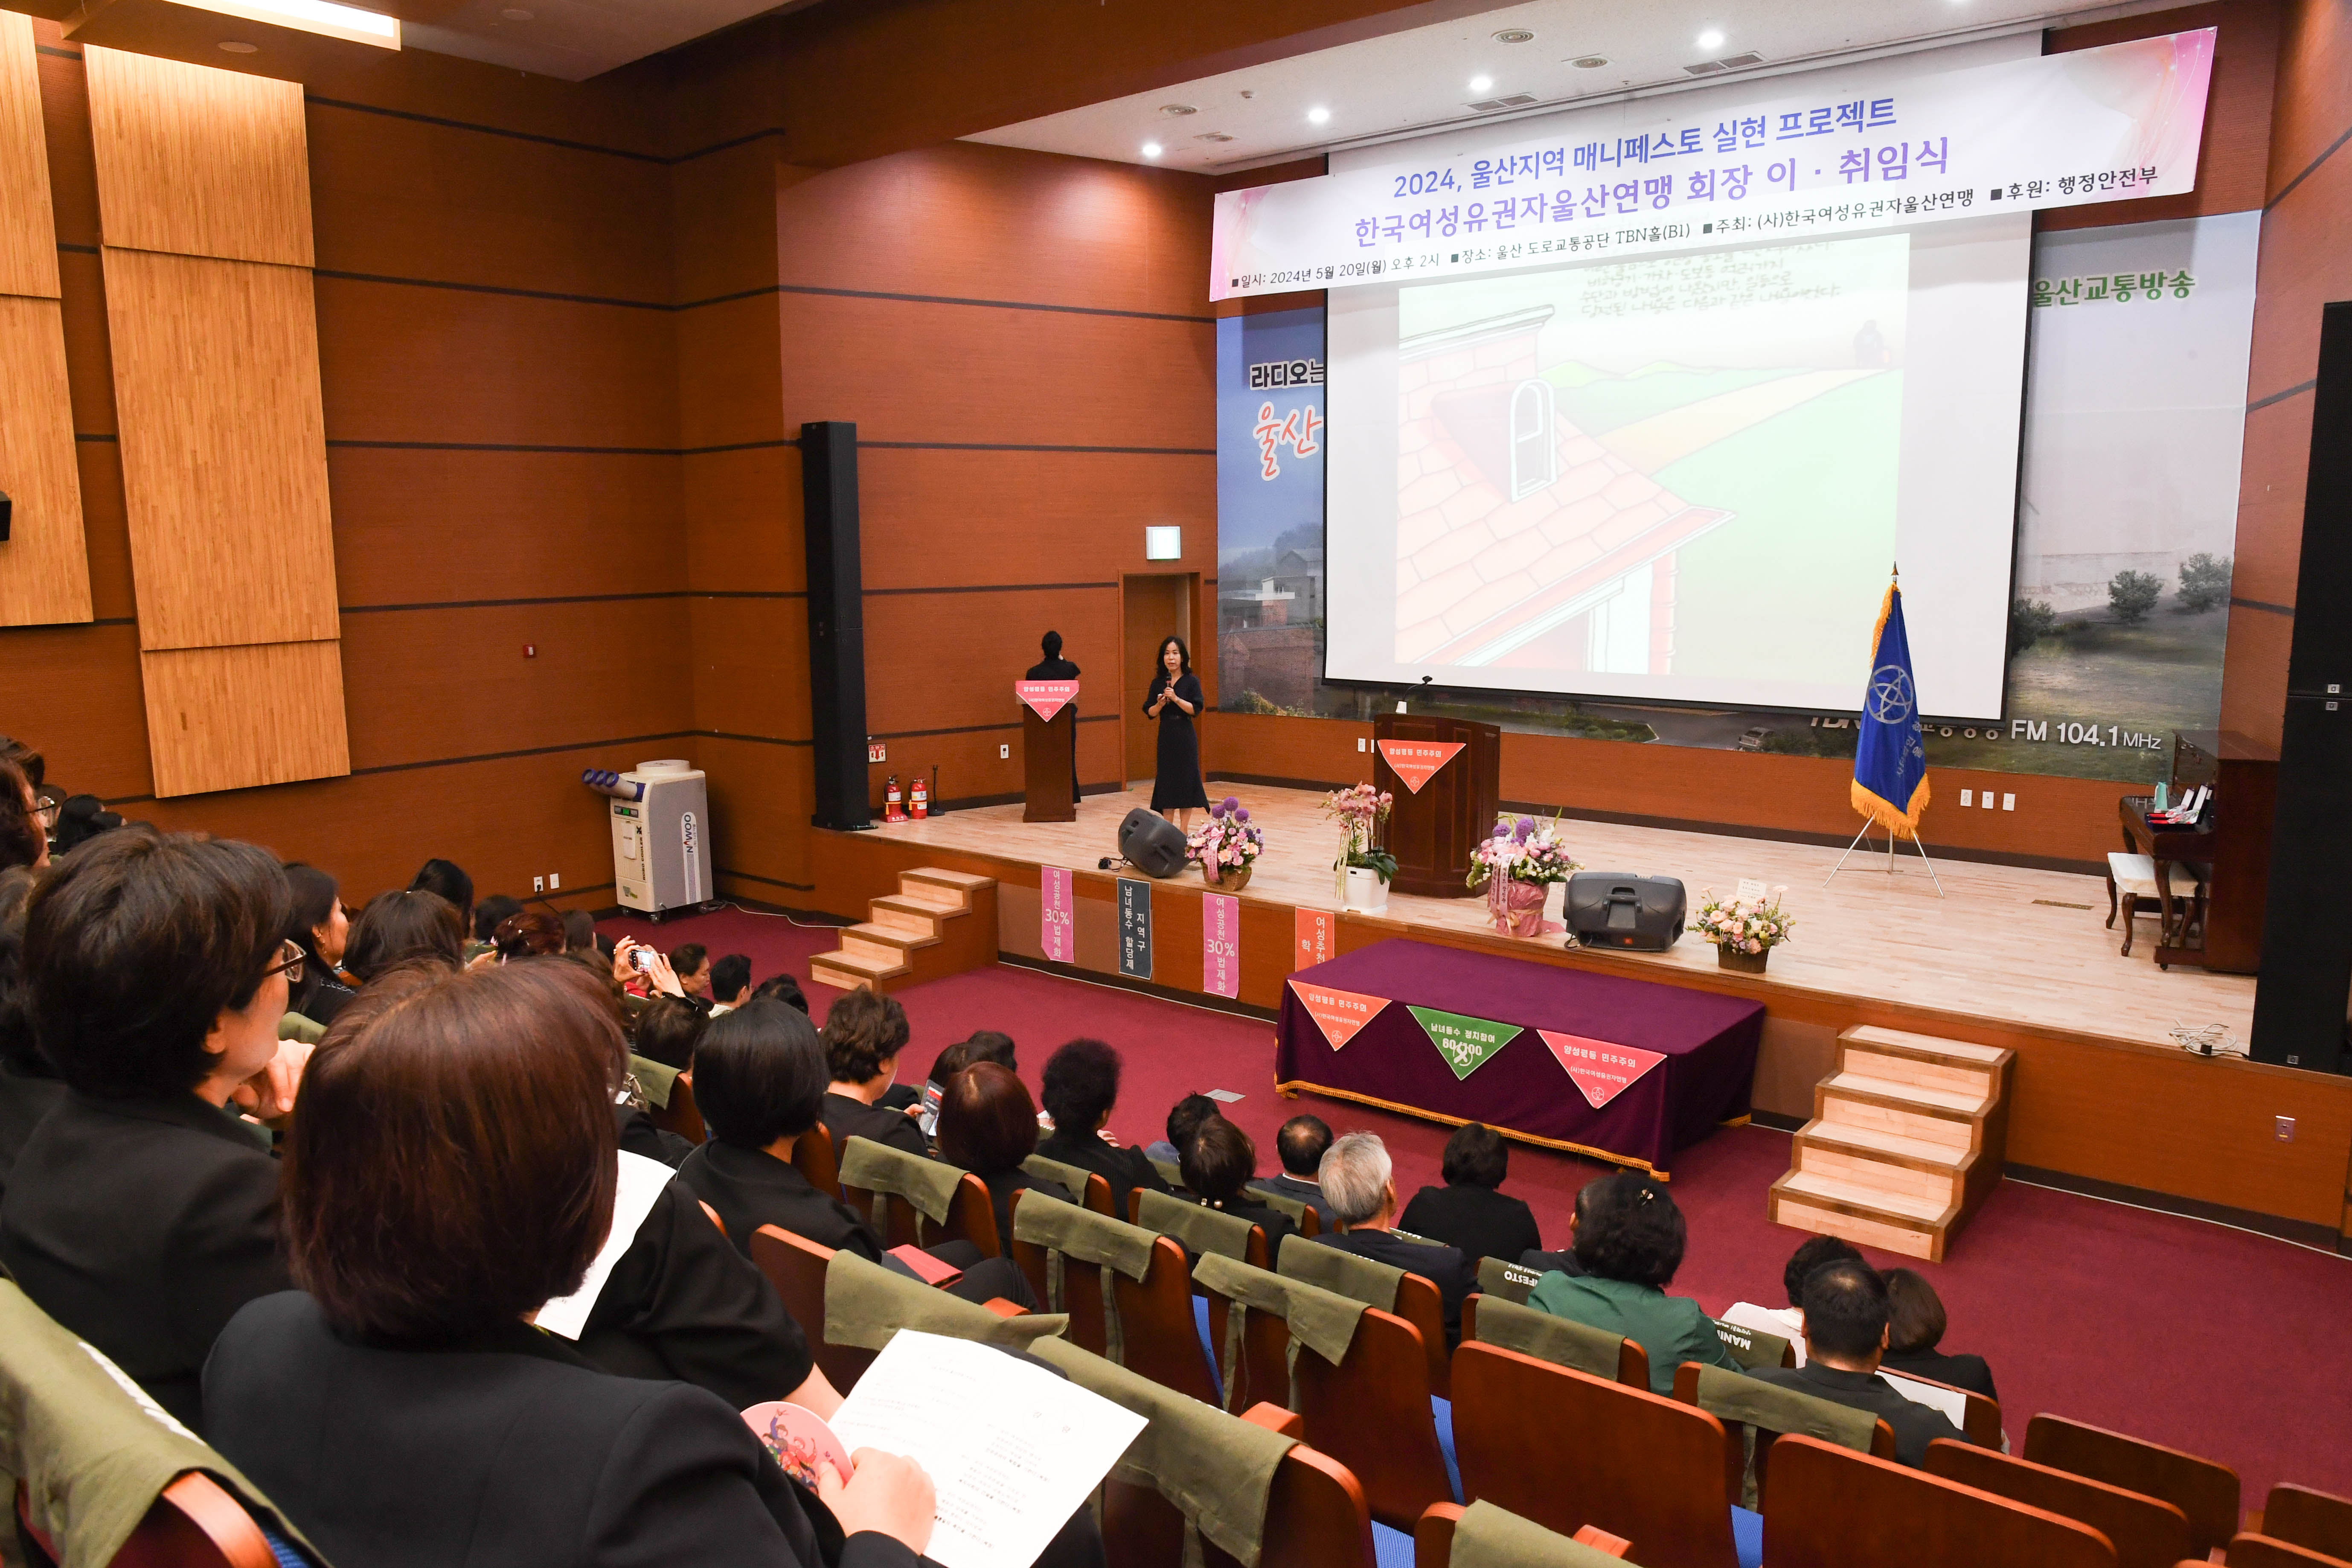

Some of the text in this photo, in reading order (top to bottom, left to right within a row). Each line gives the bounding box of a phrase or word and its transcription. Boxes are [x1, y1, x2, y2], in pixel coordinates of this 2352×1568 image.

[1394, 98, 1896, 197] 2024, 울산지역 매니페스토 실현 프로젝트
[1355, 175, 1672, 247] 한국여성유권자울산연맹
[1687, 165, 1753, 201] 회장
[1270, 269, 1311, 283] 2024년
[1316, 266, 1334, 279] 5월
[1340, 260, 1386, 276] 20일(월)
[1392, 256, 1413, 270] 오후
[1420, 253, 1438, 267] 2시
[1497, 244, 1521, 259] 울산
[1528, 233, 1609, 254] 도로교통공단
[1616, 224, 1689, 244] TBN홀(B1)
[1758, 189, 1973, 230] (사)한국여성유권자울산연맹
[2058, 166, 2157, 195] 행정안전부
[2033, 271, 2195, 307] 울산교통방송
[1252, 361, 1323, 387] 라디오는
[1256, 406, 1322, 476] 울산
[2011, 720, 2047, 741] FM
[2057, 723, 2118, 747] 104.1
[2123, 731, 2161, 749] MHz
[1045, 908, 1070, 925] 30%
[1125, 885, 1134, 970] 남녀동수 할당제
[1137, 913, 1146, 951] 지역구
[1053, 925, 1061, 958] 법제화
[1207, 897, 1235, 993] 여성공천 30% 법제화
[1309, 993, 1366, 1012] 양성평등 민주주의
[1431, 1023, 1495, 1044] 남녀동수 정치참여
[1564, 1045, 1636, 1068] 양성평등 민주주의
